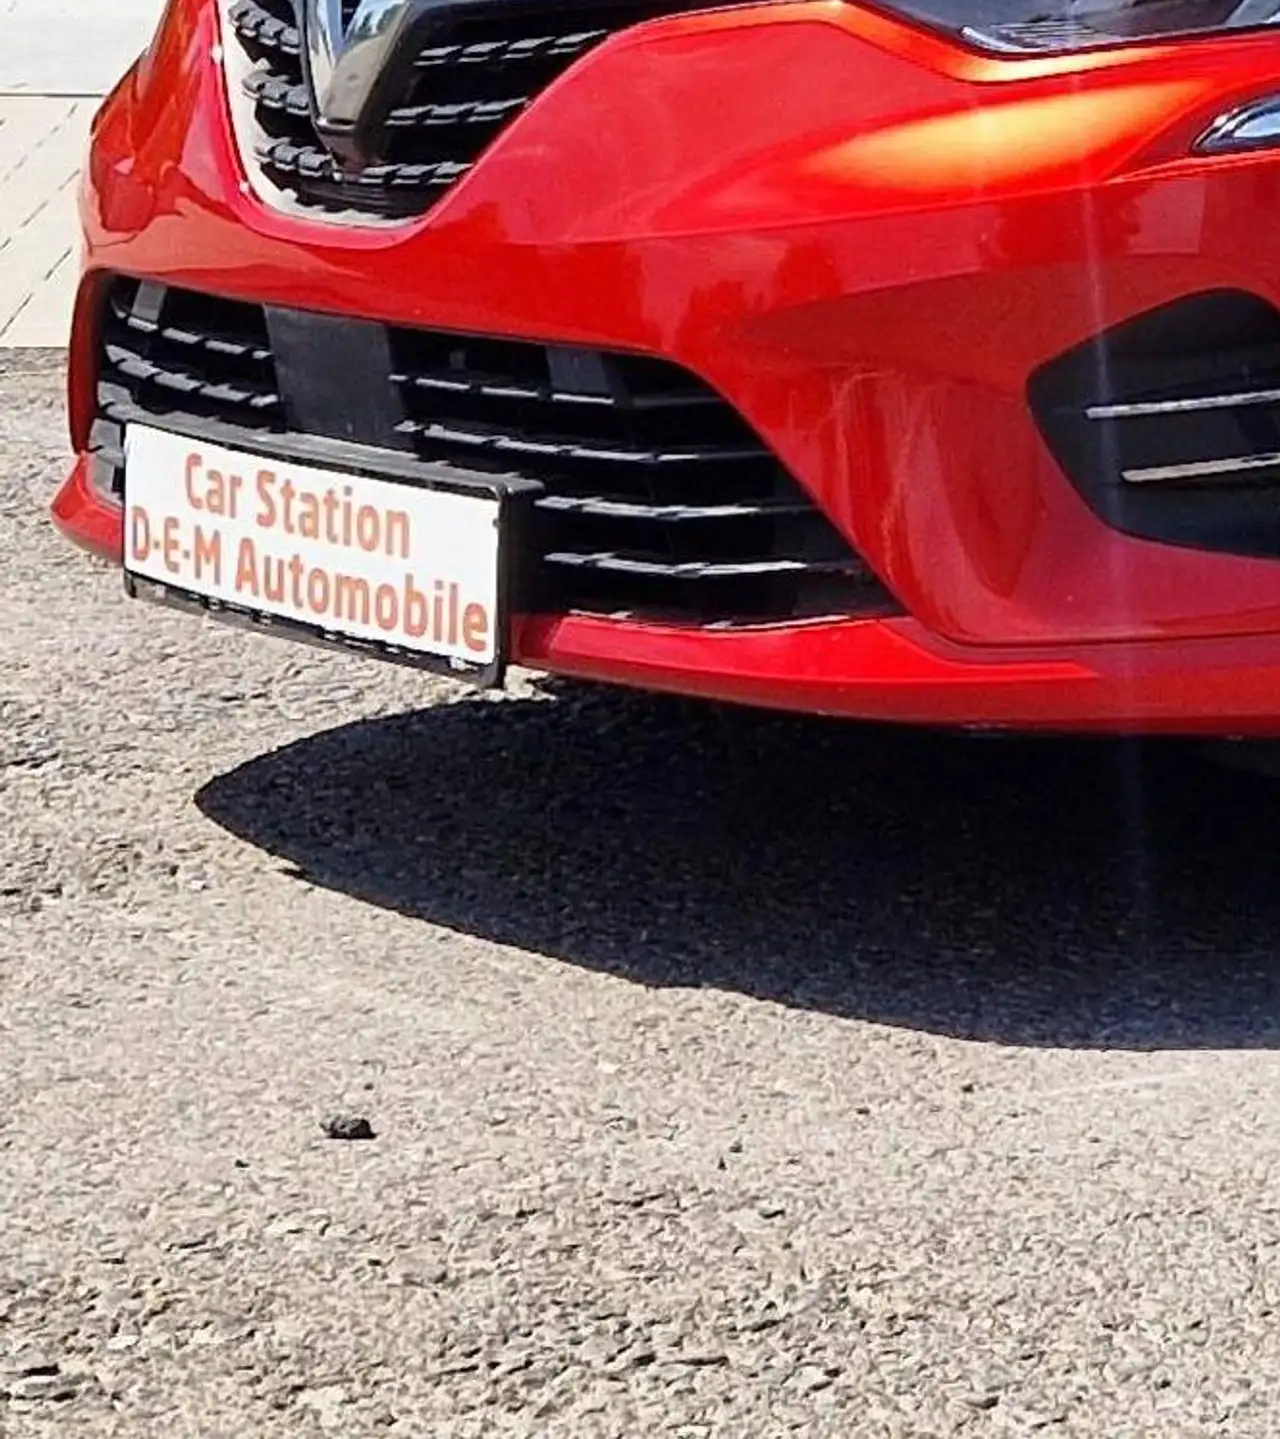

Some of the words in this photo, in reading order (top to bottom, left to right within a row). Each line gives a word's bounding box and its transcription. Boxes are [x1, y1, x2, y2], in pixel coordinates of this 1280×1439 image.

[184, 452, 243, 519] Car
[256, 469, 410, 559] Station
[235, 537, 488, 651] Automobile
